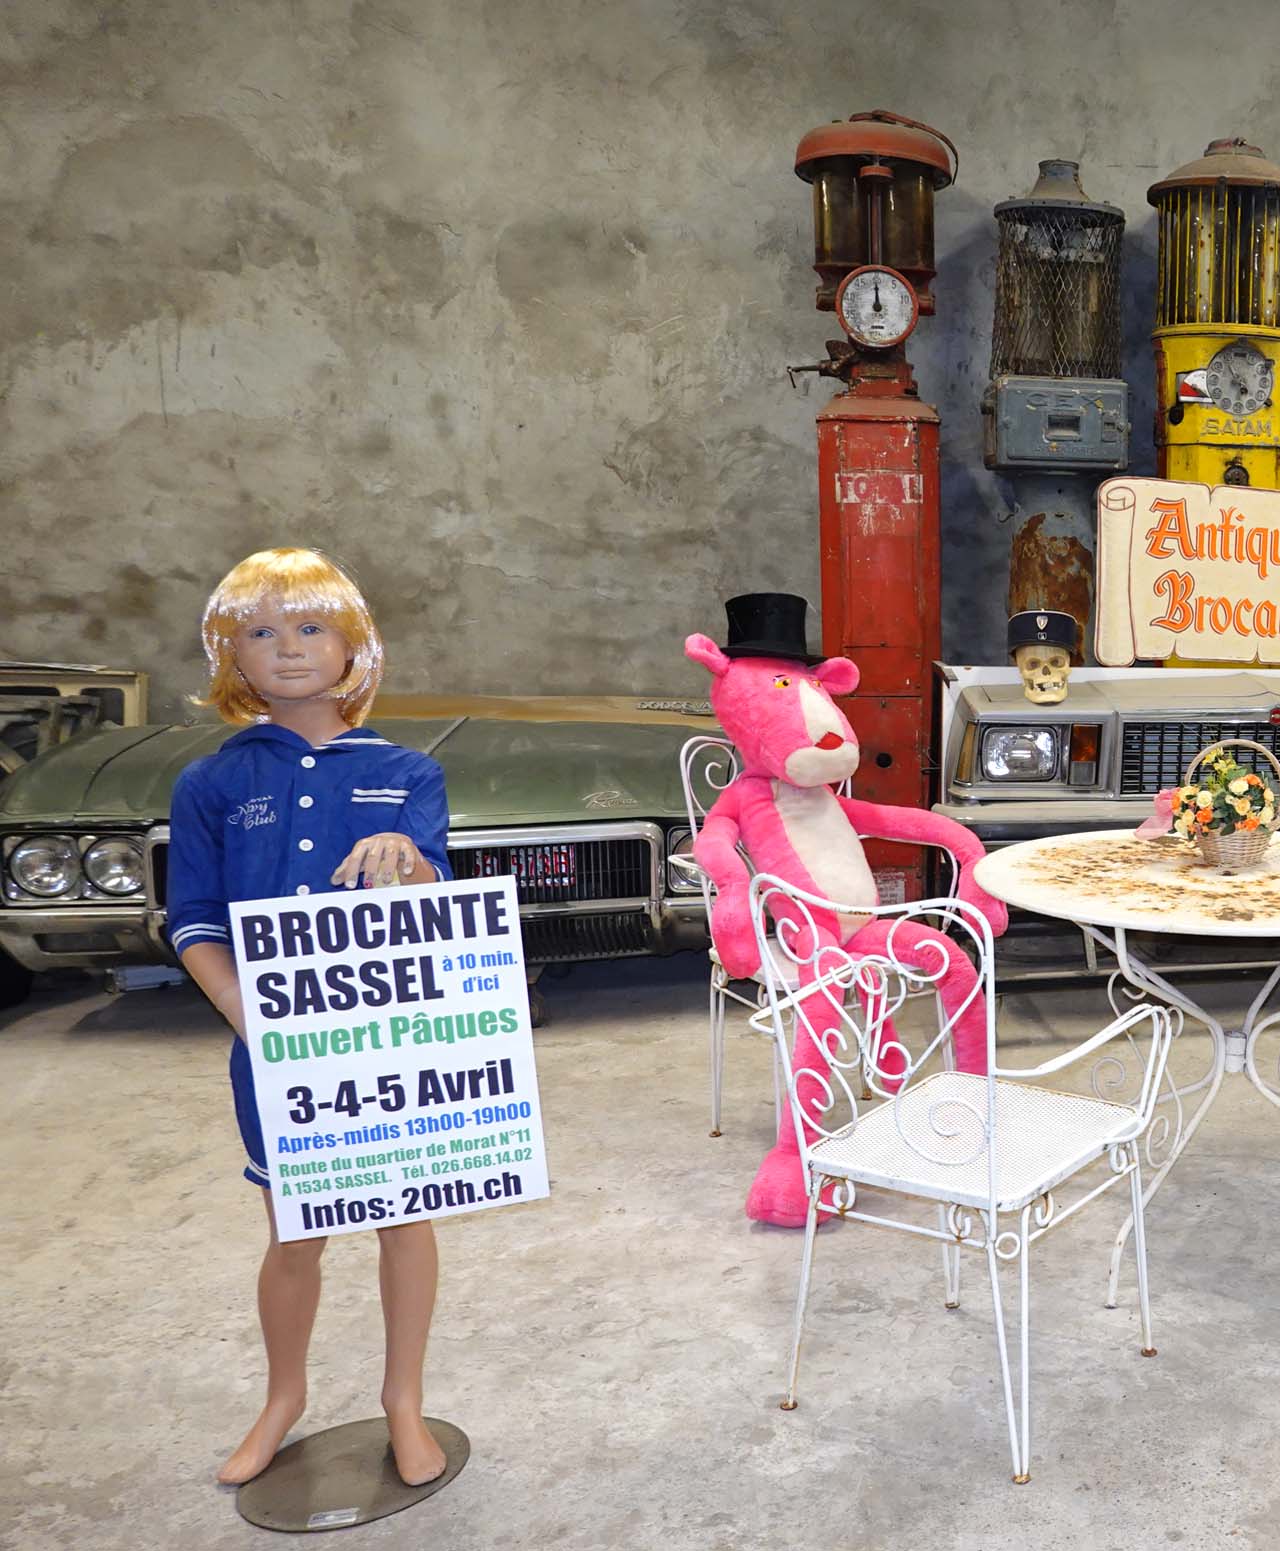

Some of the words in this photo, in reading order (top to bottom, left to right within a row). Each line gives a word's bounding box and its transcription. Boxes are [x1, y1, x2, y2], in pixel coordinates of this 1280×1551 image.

[1204, 418, 1272, 437] SATAM
[243, 811, 277, 830] Club
[241, 890, 510, 962] BROCANTE
[442, 955, 453, 972] à
[457, 953, 476, 970] 10
[480, 950, 517, 967] min.
[463, 974, 499, 993] d'ici
[256, 955, 444, 1020] SASSEL
[262, 1021, 383, 1063] Ouvert
[389, 1007, 519, 1047] Pâques
[287, 1074, 406, 1124] 3-4-5
[418, 1058, 515, 1107] Avril
[278, 1123, 400, 1153] Après-midis
[405, 1101, 531, 1136] 13h00-19h00
[279, 1160, 327, 1178] Route
[332, 1157, 352, 1172] du
[356, 1148, 422, 1169] quartier
[426, 1143, 446, 1157] de
[450, 1134, 496, 1153] Morat
[499, 1128, 531, 1146] N°11
[282, 1181, 292, 1196] À
[295, 1179, 331, 1194] 1534
[334, 1171, 392, 1189] SASSEL.
[401, 1165, 429, 1180] Tél.
[431, 1147, 532, 1175] 026.668.14.02
[301, 1198, 396, 1230] Infos:
[402, 1172, 522, 1215] 20th.ch
